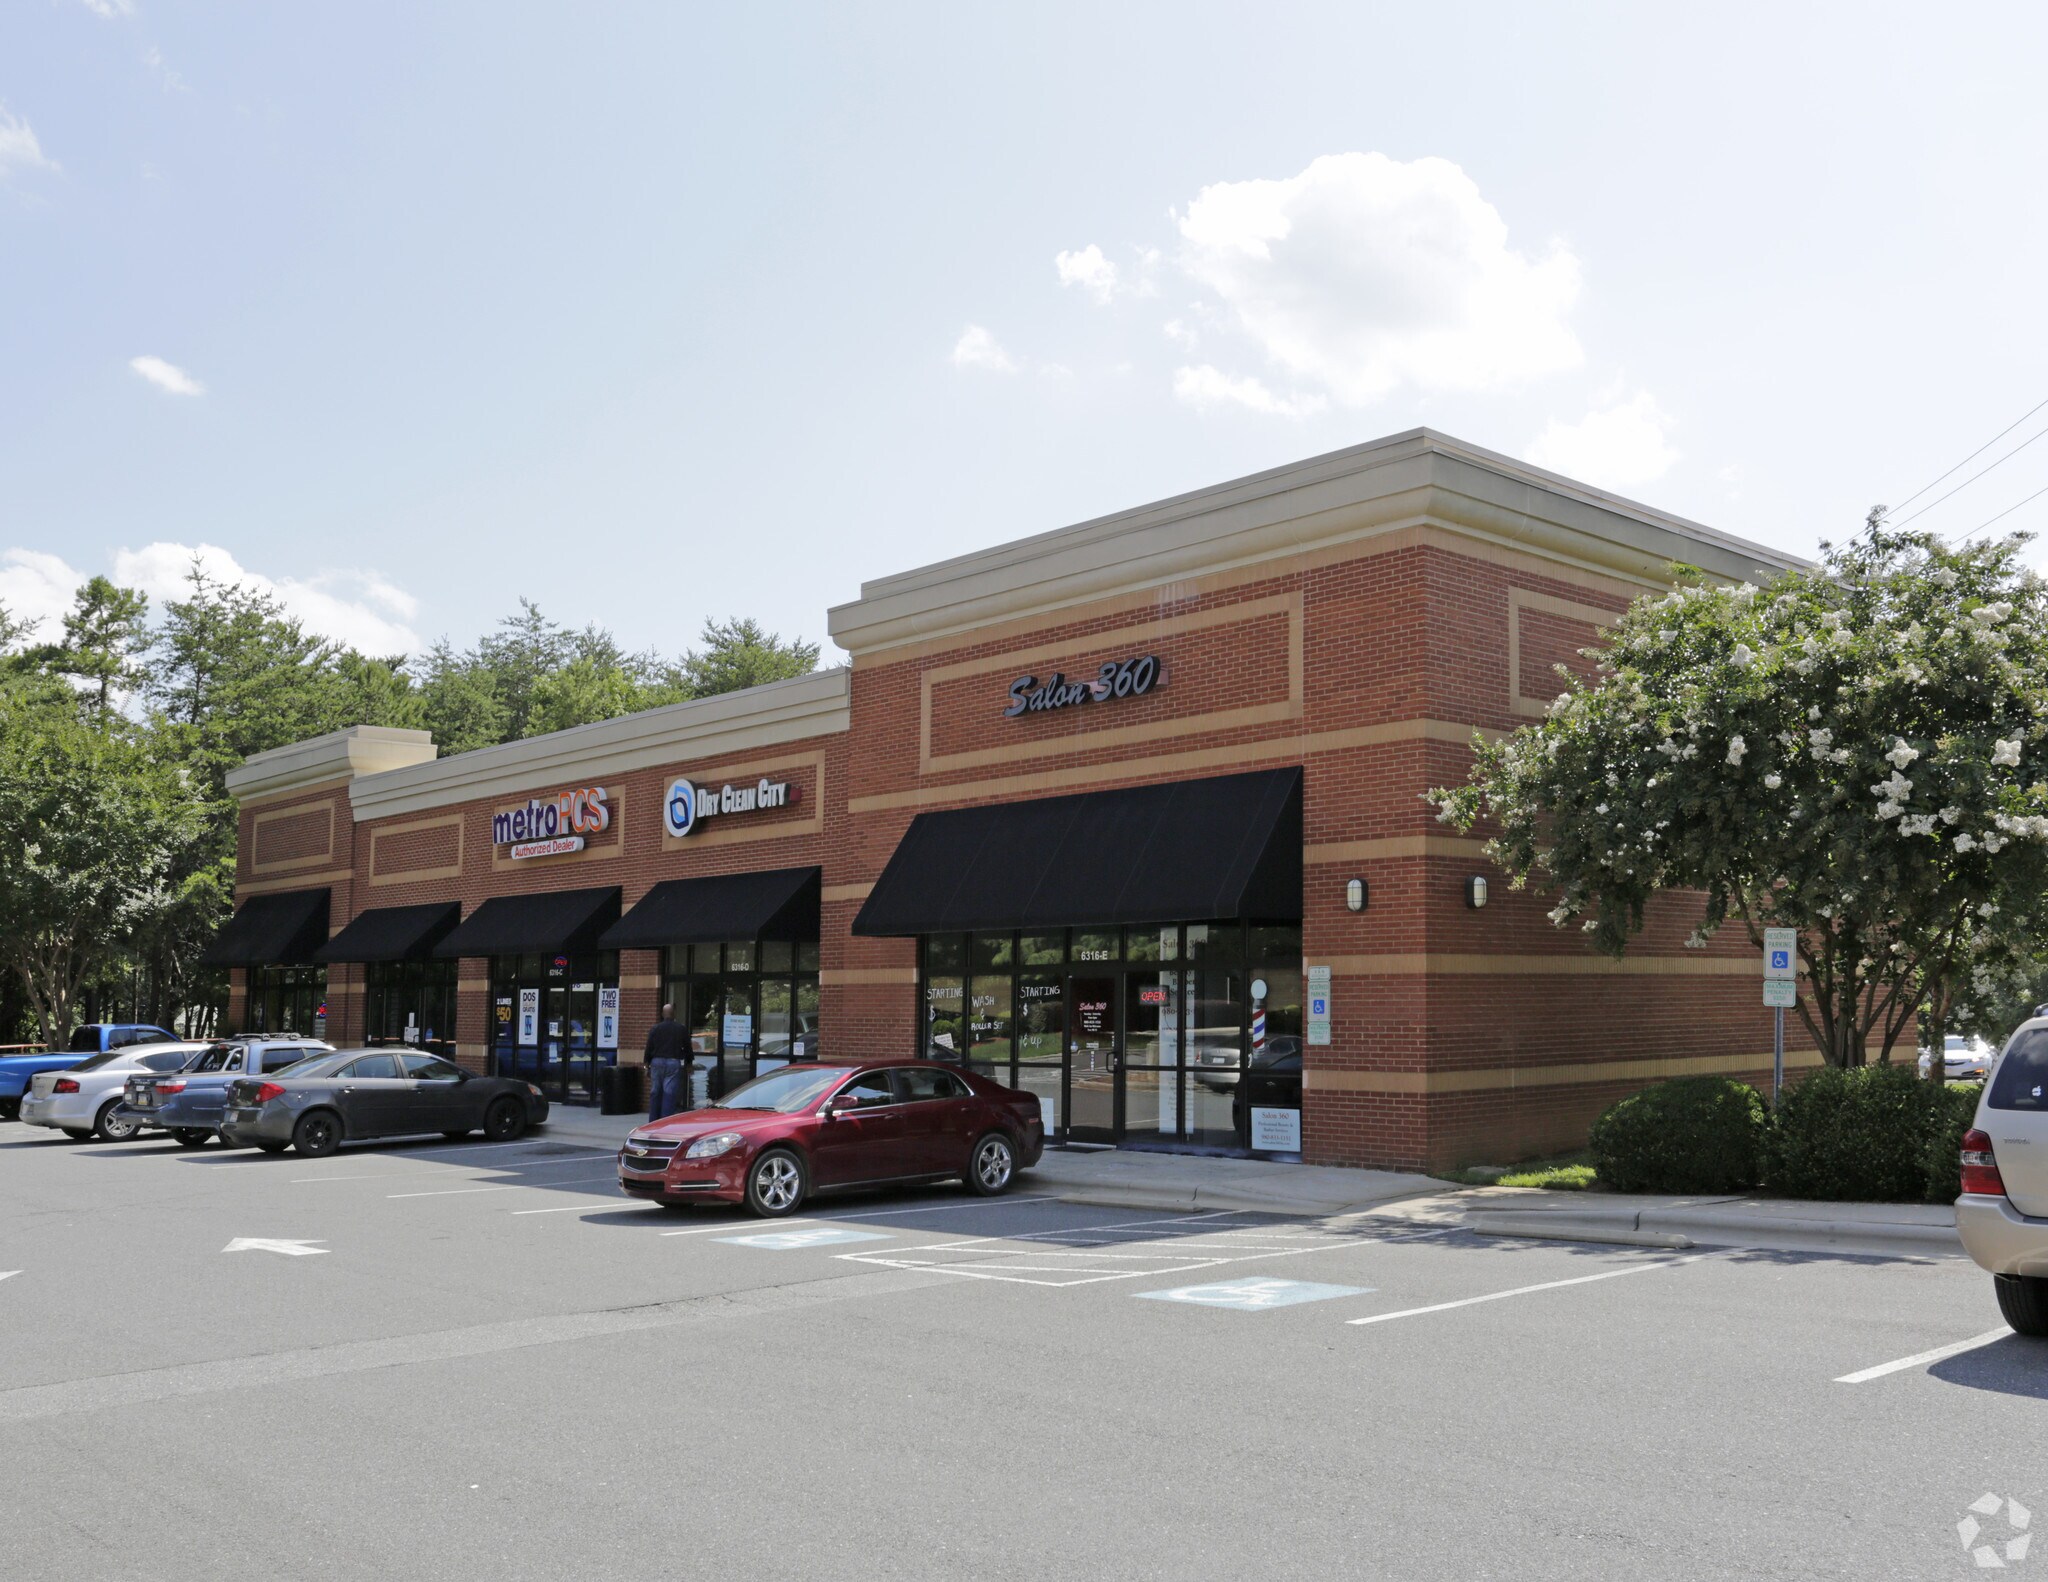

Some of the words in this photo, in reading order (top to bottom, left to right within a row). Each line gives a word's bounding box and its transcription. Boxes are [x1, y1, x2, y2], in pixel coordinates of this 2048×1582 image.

[1003, 672, 1089, 717] Salon
[1093, 655, 1159, 702] 360
[492, 787, 607, 844] metroPCS
[515, 842, 552, 858] Authorized
[552, 839, 576, 853] Dealer
[1081, 950, 1108, 961] 6316-E
[731, 963, 750, 971] 6316-D
[522, 992, 536, 1001] DOS
[602, 990, 617, 999] TWO
[926, 987, 964, 1001] STARTING
[1020, 985, 1061, 999] STARTING
[1141, 991, 1167, 1001] OPEN
[601, 1000, 616, 1008] FREE
[972, 995, 995, 1008] WASH
[1079, 1002, 1095, 1011] Salon
[1095, 1002, 1107, 1010] 360
[496, 1006, 512, 1021] $50
[971, 1022, 992, 1031] ROLLER
[1030, 1036, 1043, 1048] up
[1262, 1111, 1278, 1119] Salon
